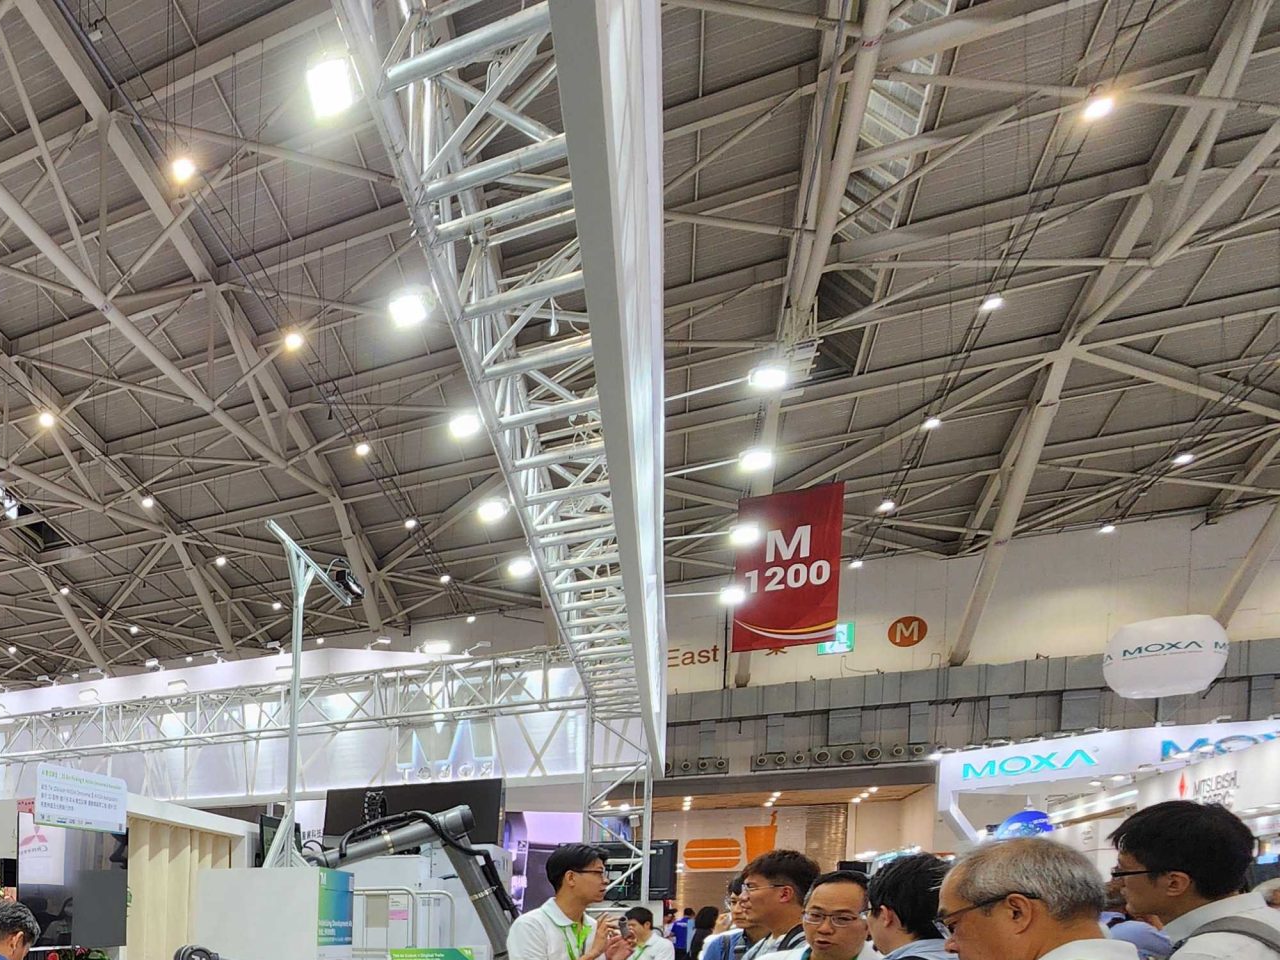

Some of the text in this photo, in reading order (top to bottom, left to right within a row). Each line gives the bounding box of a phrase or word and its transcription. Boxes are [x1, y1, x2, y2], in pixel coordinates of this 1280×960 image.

[765, 524, 812, 563] M
[745, 559, 831, 593] 1200
[895, 621, 919, 643] M
[667, 645, 720, 669] East
[1123, 641, 1203, 657] MOXA
[962, 749, 1096, 780] MOXA
